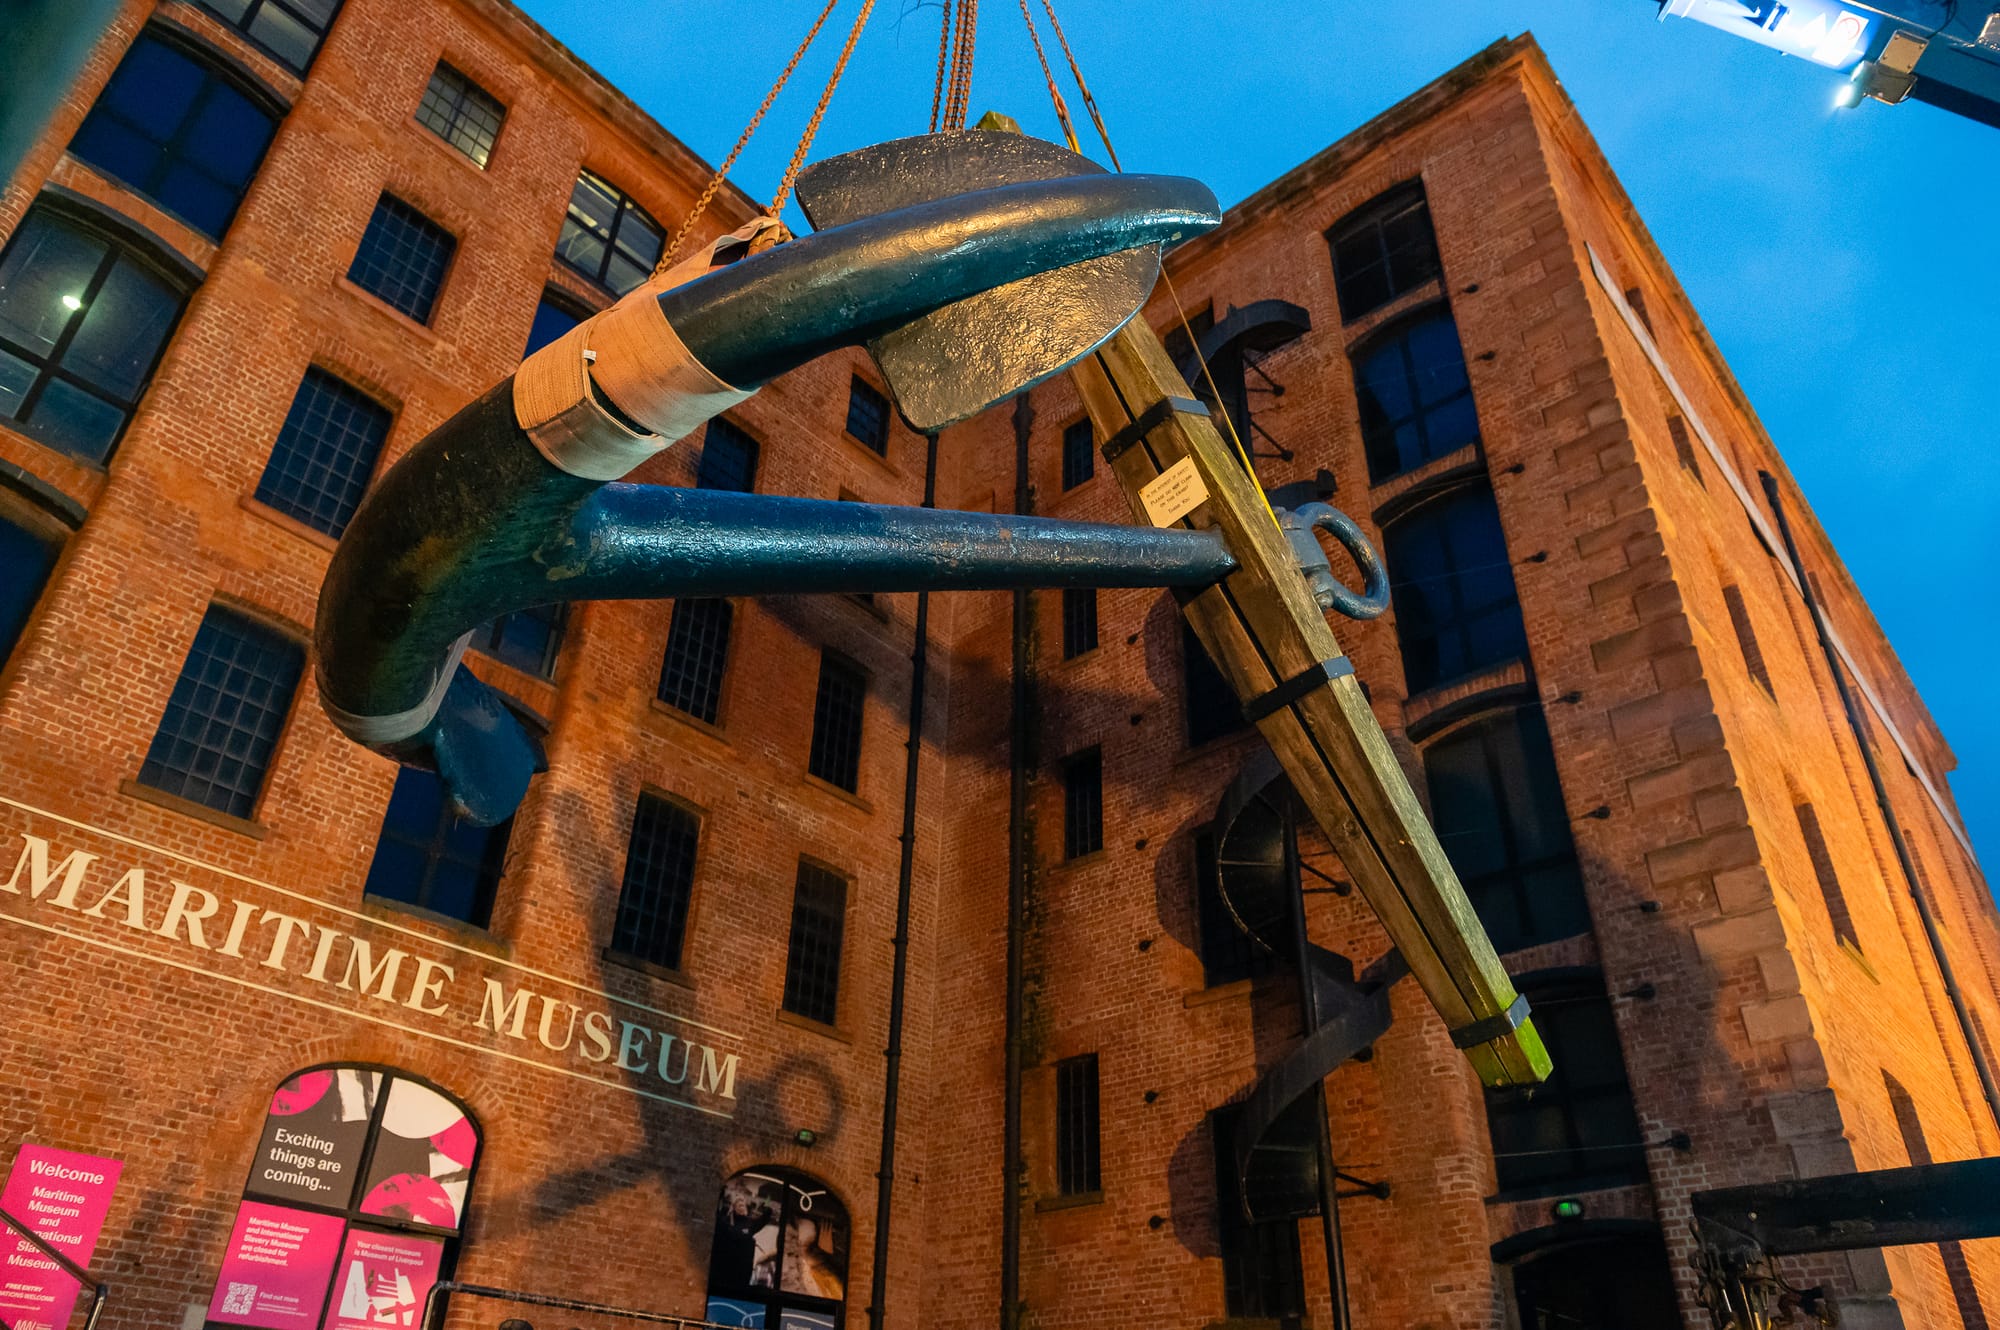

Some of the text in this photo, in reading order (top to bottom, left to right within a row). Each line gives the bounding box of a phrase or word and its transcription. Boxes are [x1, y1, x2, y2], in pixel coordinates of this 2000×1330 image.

[0, 833, 741, 1100] MARITIME MUSEUM
[275, 1128, 334, 1155] Exciting
[270, 1148, 341, 1173] things are
[30, 1159, 104, 1185] Welcome
[264, 1168, 331, 1191] coming...
[32, 1186, 85, 1204] Maritime
[27, 1200, 80, 1217] Museum
[39, 1217, 60, 1227] and
[249, 1217, 310, 1233] Maritime Museum
[244, 1234, 300, 1250] Slavery Museum
[260, 1228, 303, 1241] International
[253, 1246, 278, 1256] closed
[278, 1249, 288, 1257] for
